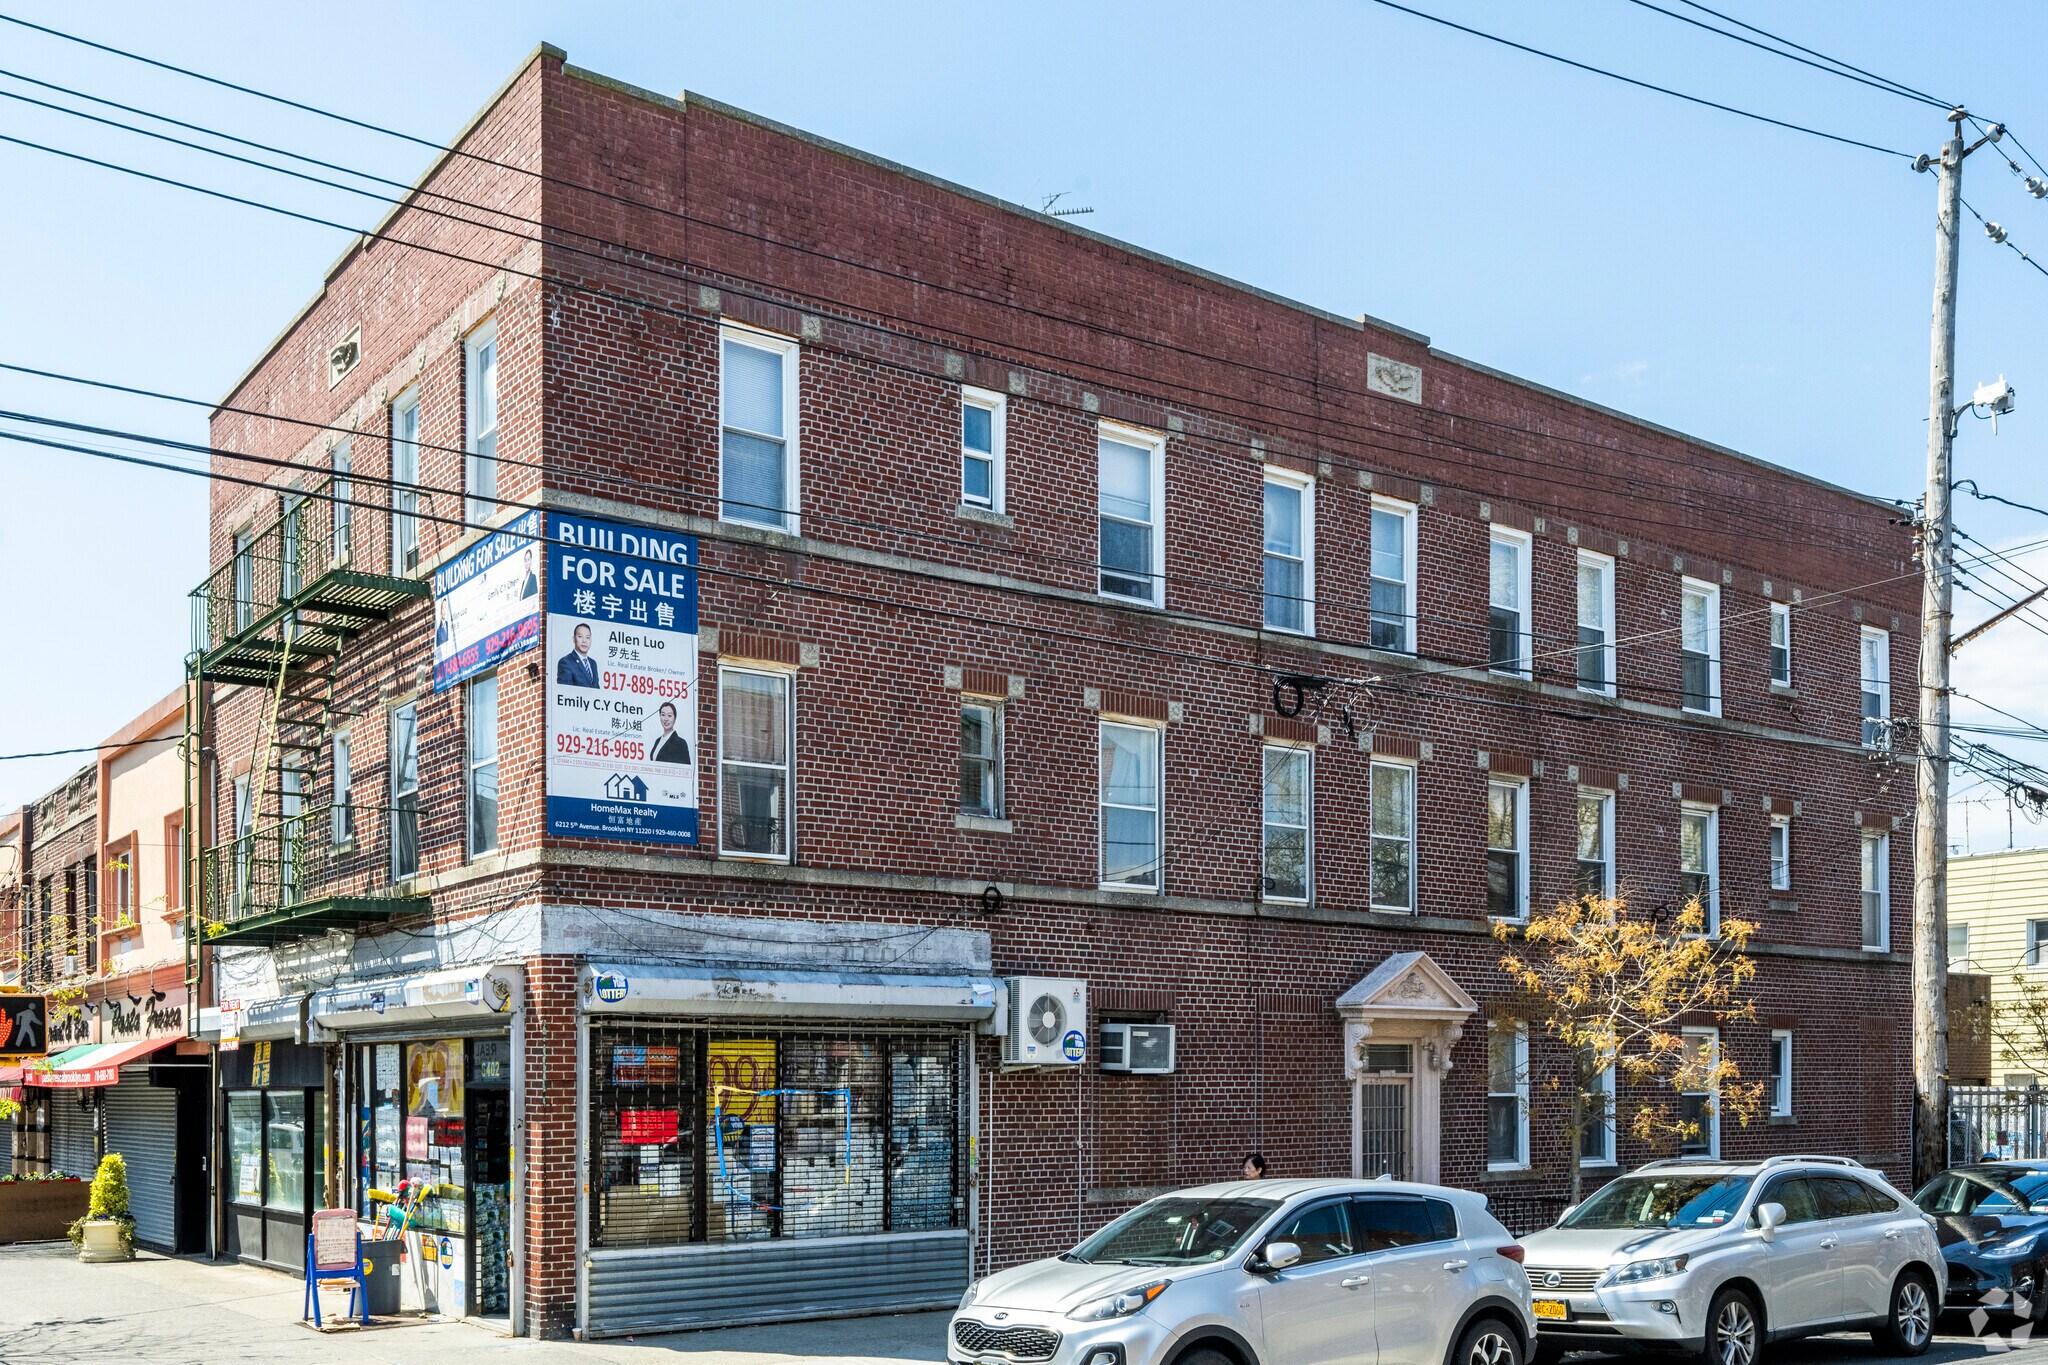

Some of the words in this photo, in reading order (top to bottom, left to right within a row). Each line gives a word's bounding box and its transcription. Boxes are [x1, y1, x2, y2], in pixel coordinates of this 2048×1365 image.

[559, 522, 687, 566] BUILDING
[437, 553, 474, 596] BUILDING
[476, 542, 494, 572] FOR
[494, 526, 516, 560] SALE
[562, 555, 616, 588] FOR
[624, 566, 685, 599] SALE
[573, 588, 675, 627] 楼宇出售
[608, 631, 640, 646] Allen
[644, 635, 665, 650] Luo
[608, 646, 640, 662] 罗先生
[668, 668, 686, 676] Owner
[603, 671, 688, 700] 917-889-6555
[557, 694, 590, 712] Emily
[594, 699, 610, 711] C.Y
[614, 701, 644, 716] Chen
[594, 728, 611, 736] Estate
[612, 718, 642, 732] 陈小姐
[557, 734, 644, 760] 929-216-9695
[591, 803, 632, 815] HomeMax
[634, 806, 658, 819] Realty
[555, 820, 570, 828] 6212
[602, 824, 626, 833] Brooklyn
[655, 829, 691, 838] 929-460-0008
[220, 1001, 229, 1011] FOR
[230, 1000, 240, 1010] RENT
[111, 1001, 140, 1036] Pasta
[144, 996, 182, 1036] Fresca
